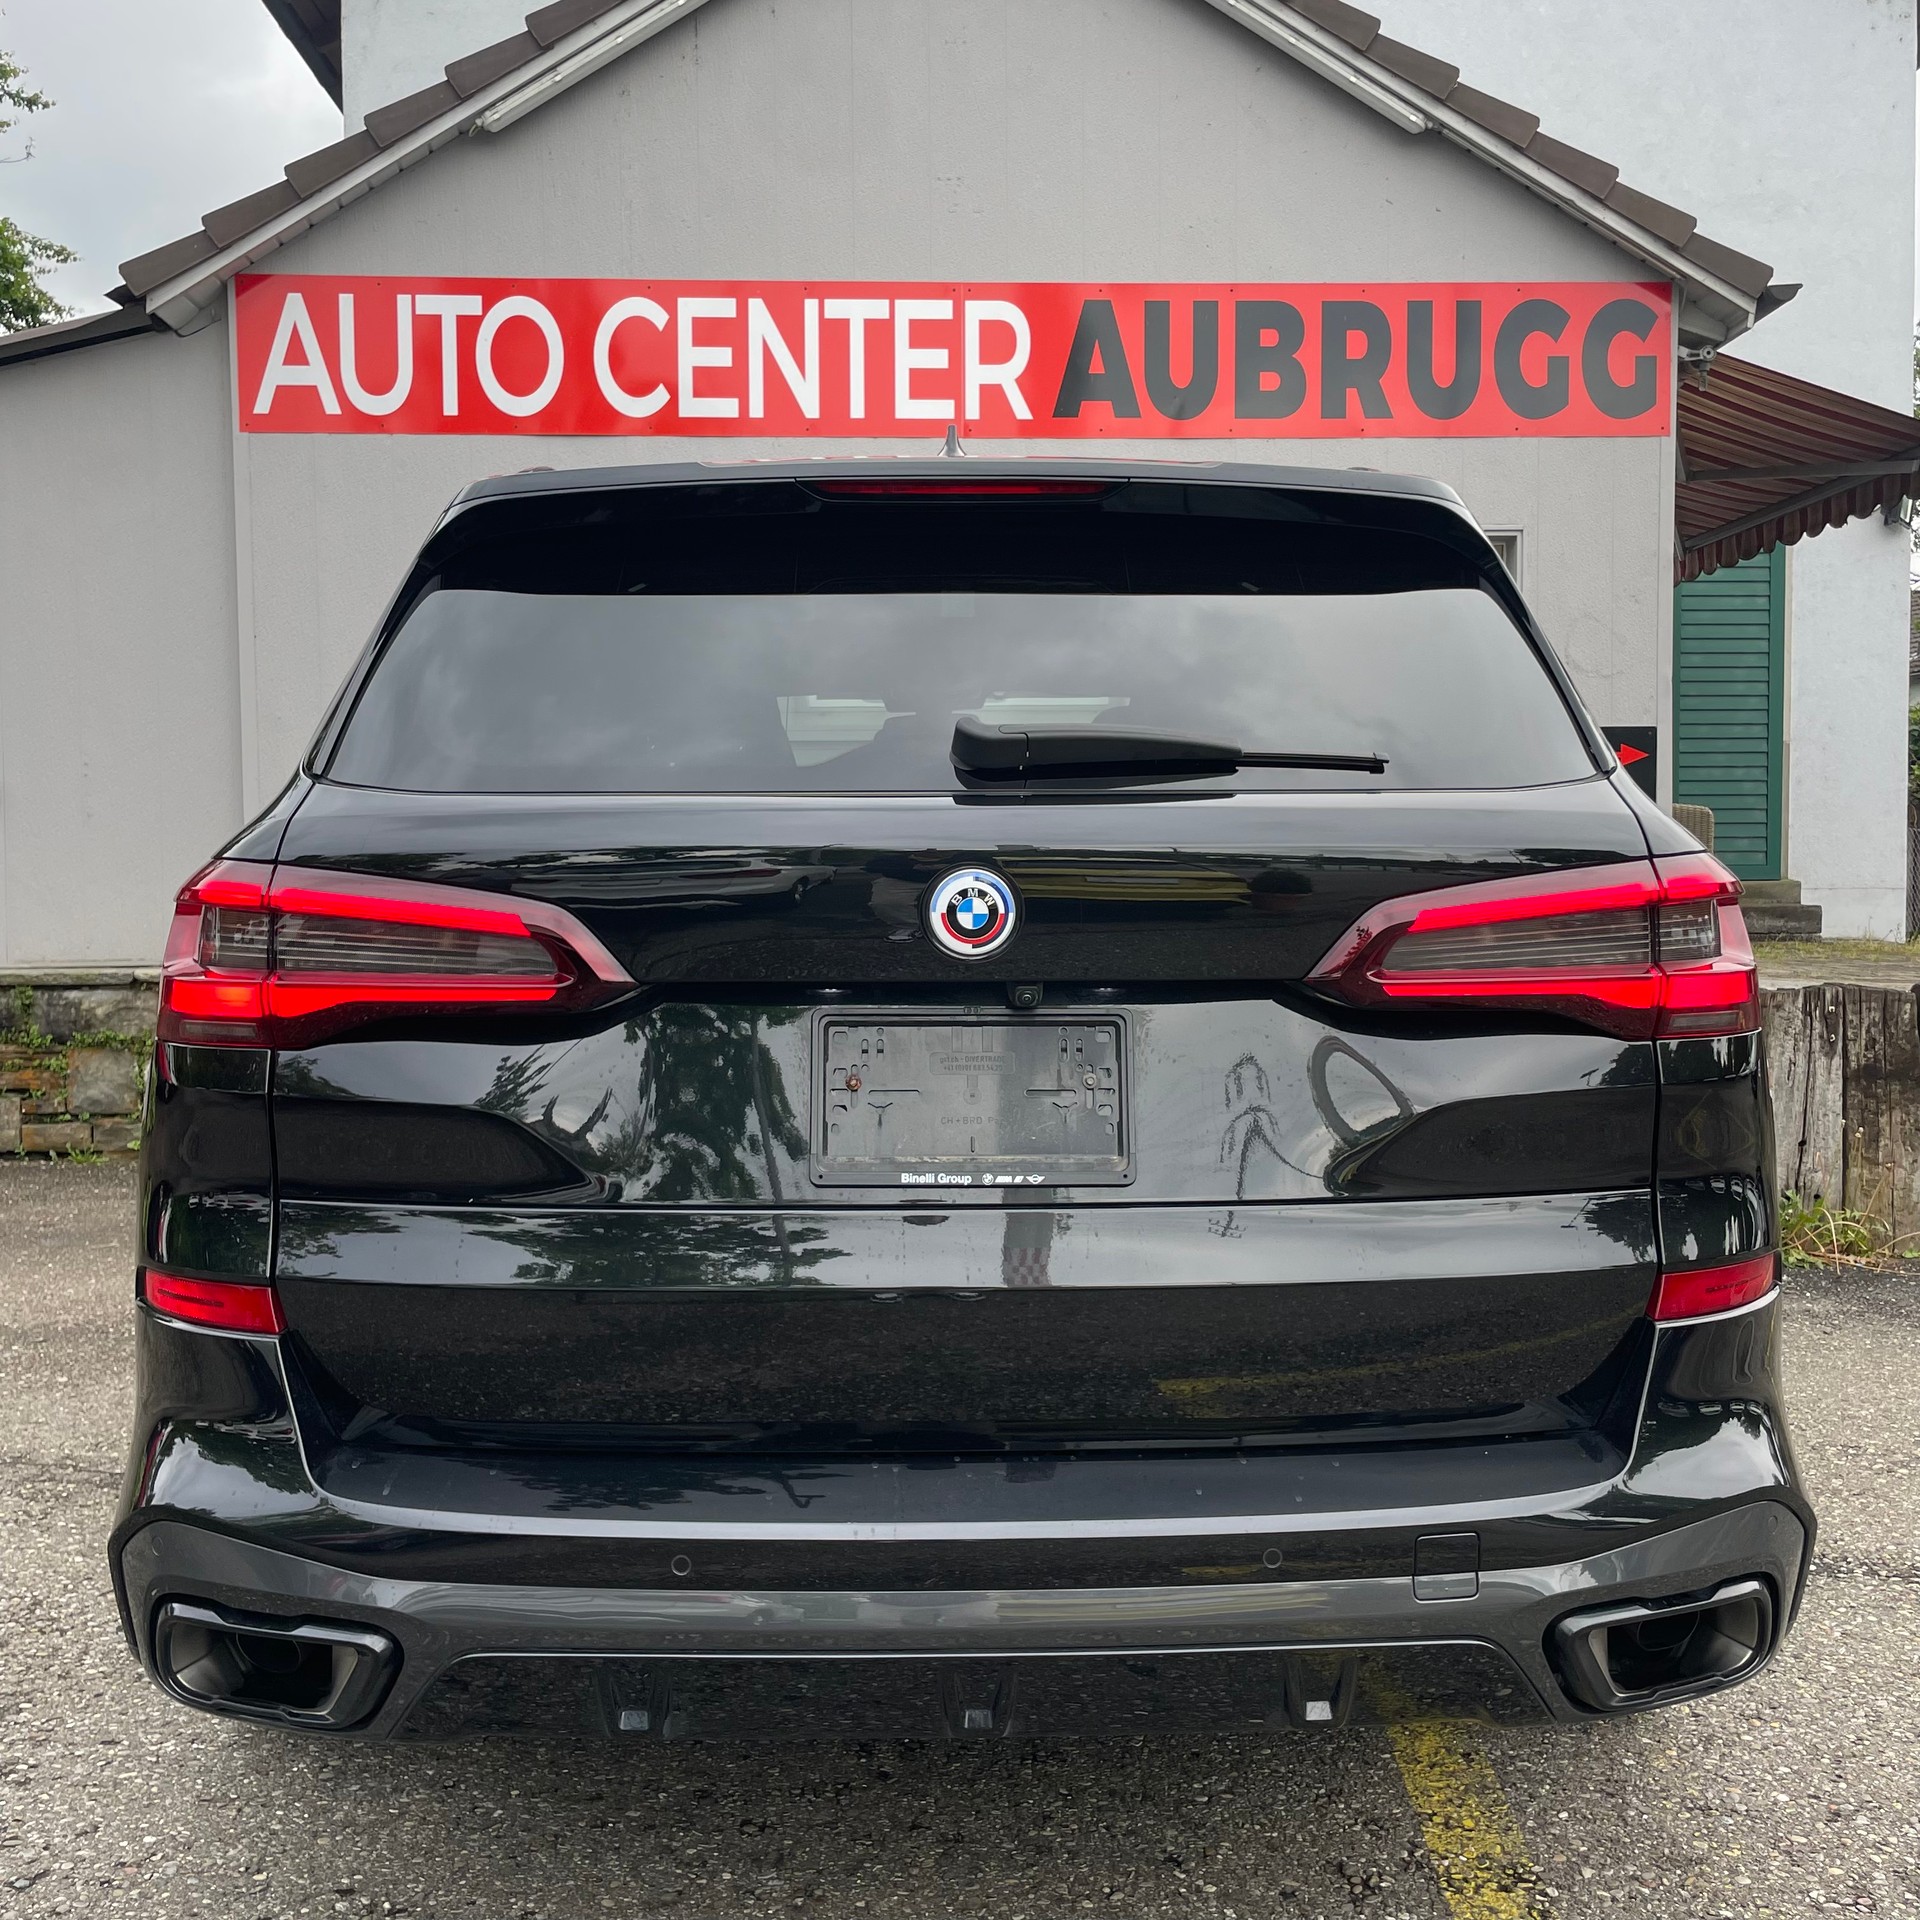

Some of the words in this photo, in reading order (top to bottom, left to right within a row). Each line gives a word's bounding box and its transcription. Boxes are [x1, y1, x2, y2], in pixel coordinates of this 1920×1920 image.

[252, 292, 565, 419] AUTO
[593, 296, 1034, 421] CENTER
[1051, 298, 1659, 421] AUBRUGG
[951, 888, 996, 906] BMW
[900, 1172, 935, 1184] Binelli
[937, 1172, 972, 1185] Group
